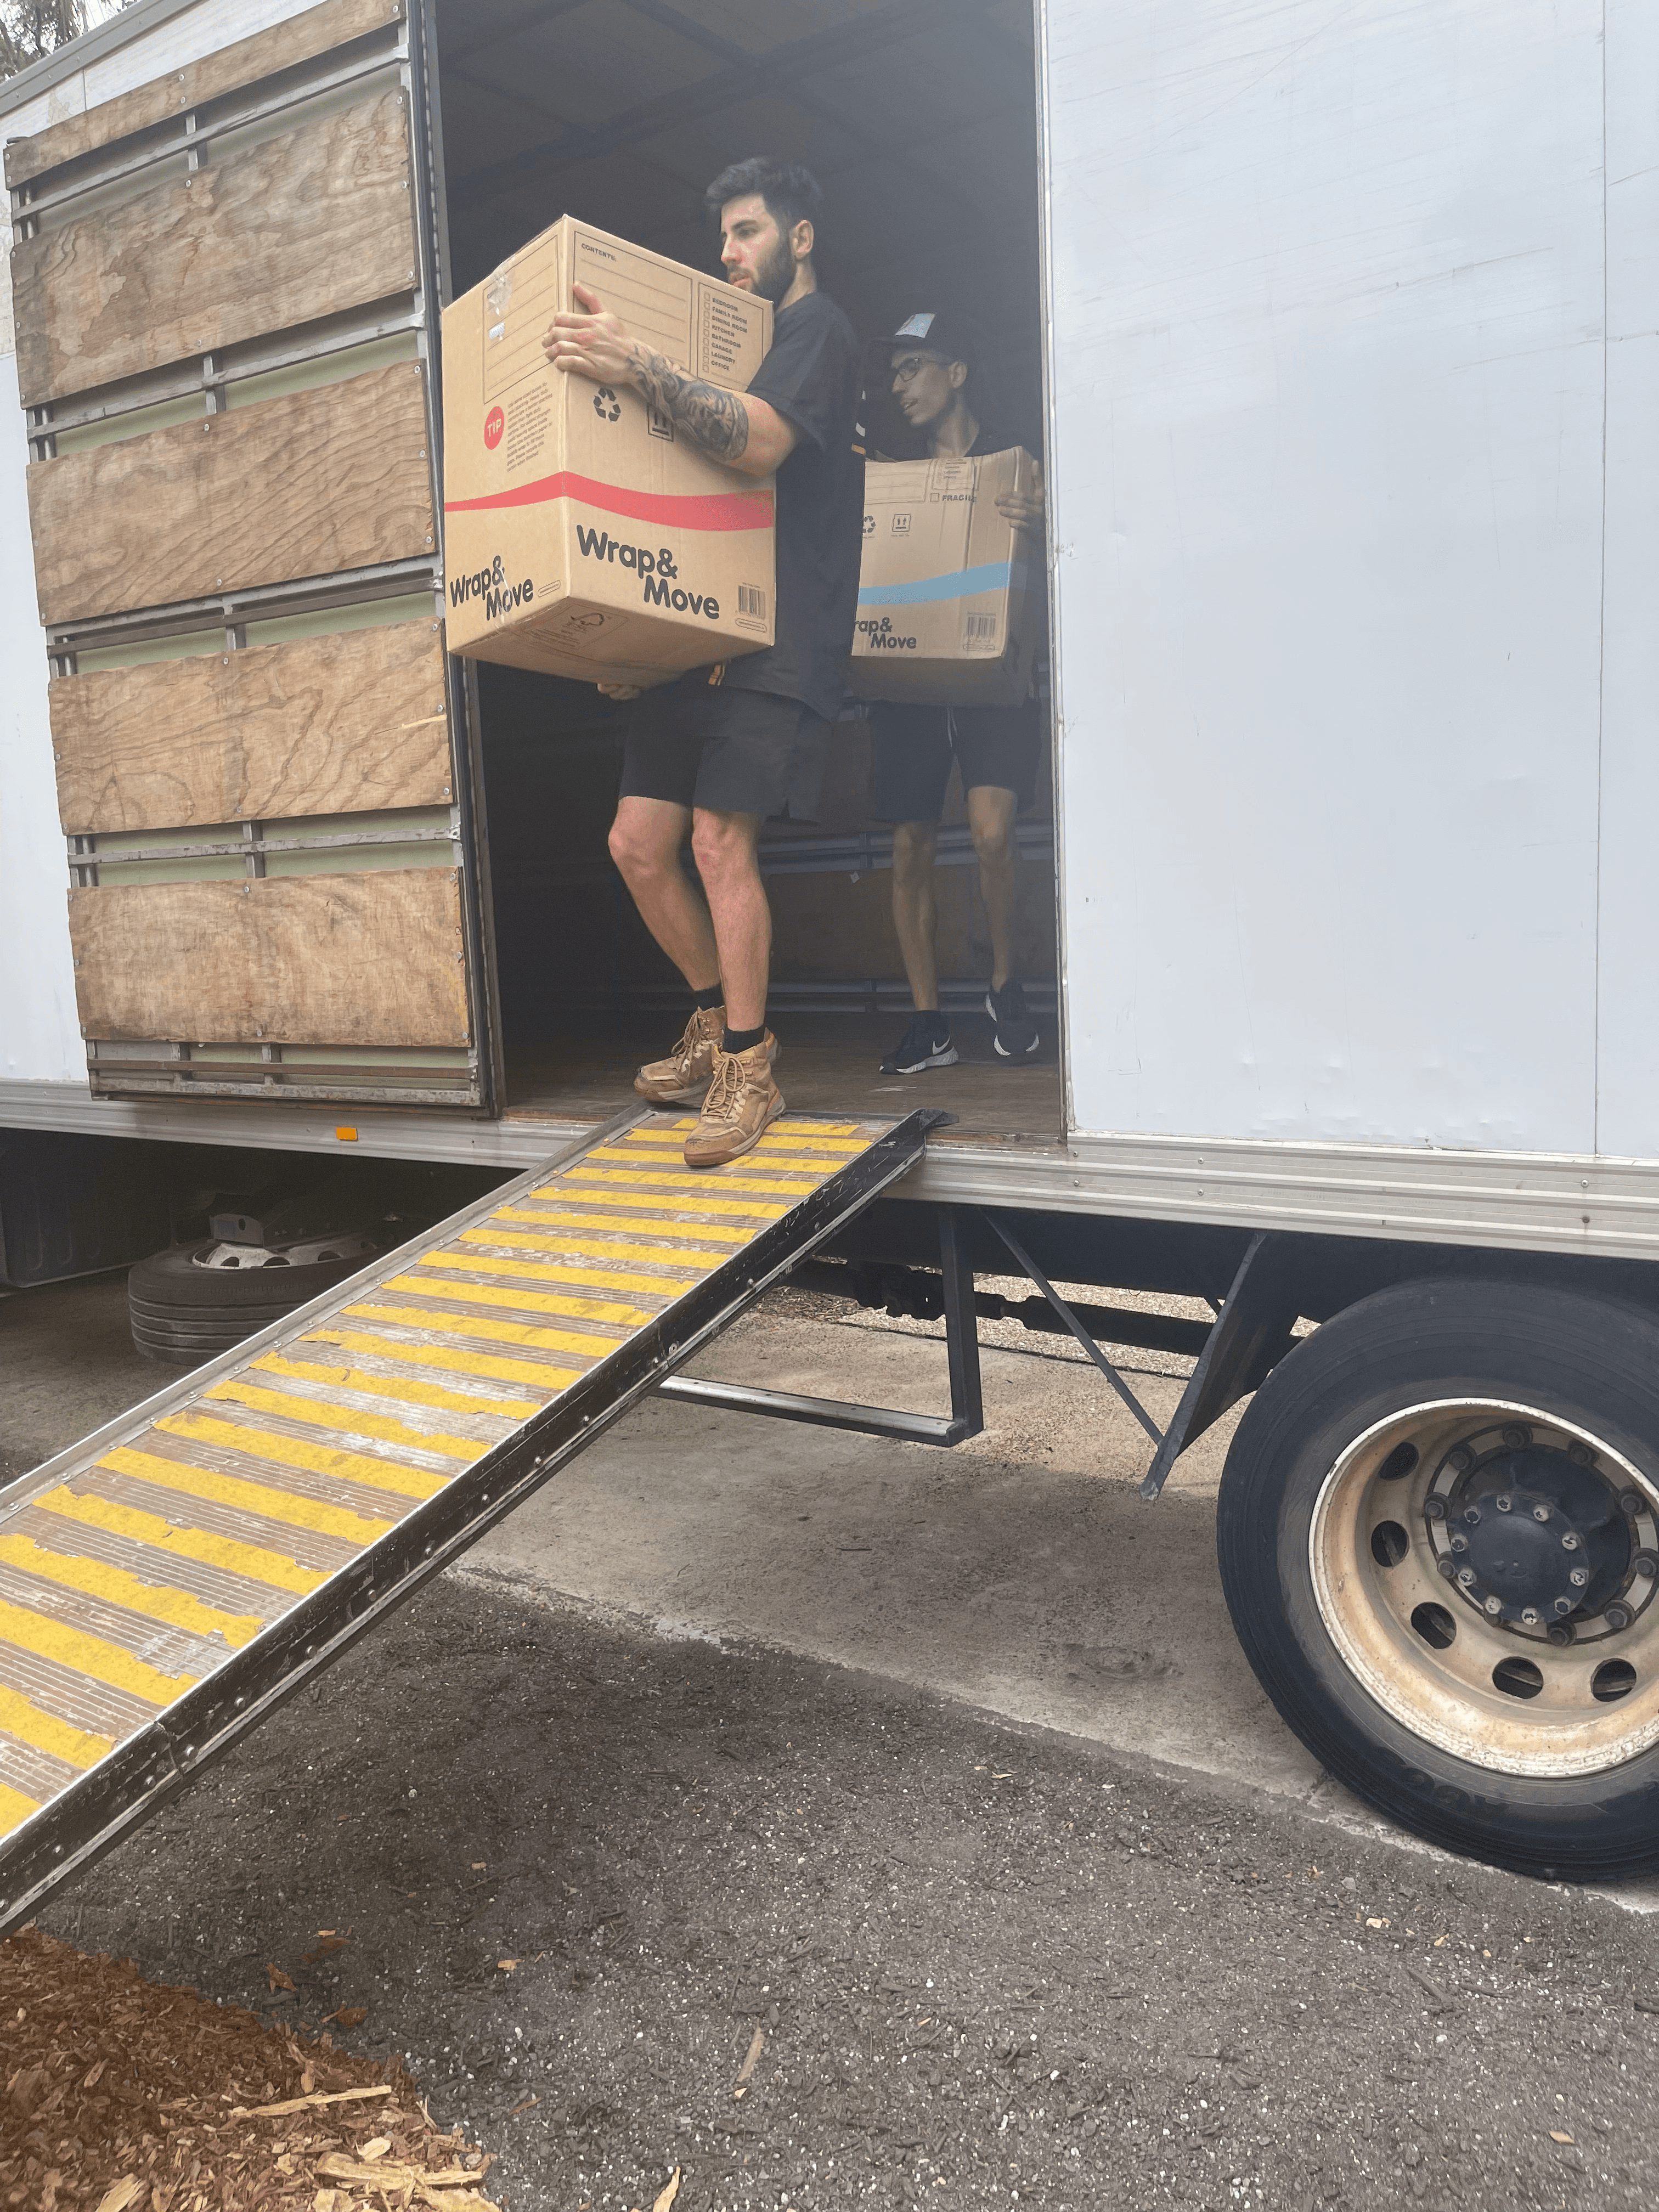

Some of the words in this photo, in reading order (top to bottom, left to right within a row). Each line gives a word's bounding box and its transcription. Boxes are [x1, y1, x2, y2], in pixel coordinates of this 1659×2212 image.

[713, 298, 738, 312] BEDROOM
[712, 307, 730, 317] FAMILY
[732, 314, 747, 324] ROOM
[712, 315, 730, 326] DINING
[732, 323, 747, 333] ROOM
[712, 324, 735, 337] KITCHEN
[711, 342, 732, 354] GARAGE
[712, 333, 741, 348] BATHROOM
[711, 351, 736, 364] LAUNDRY
[711, 360, 730, 370] OFFICE
[487, 418, 501, 438] TIP
[942, 494, 977, 503] FRAGILE
[577, 524, 678, 579] Wrap&
[450, 555, 505, 607] Wrap&
[486, 587, 534, 621] Move
[644, 574, 720, 619] Move
[871, 633, 917, 649] Move
